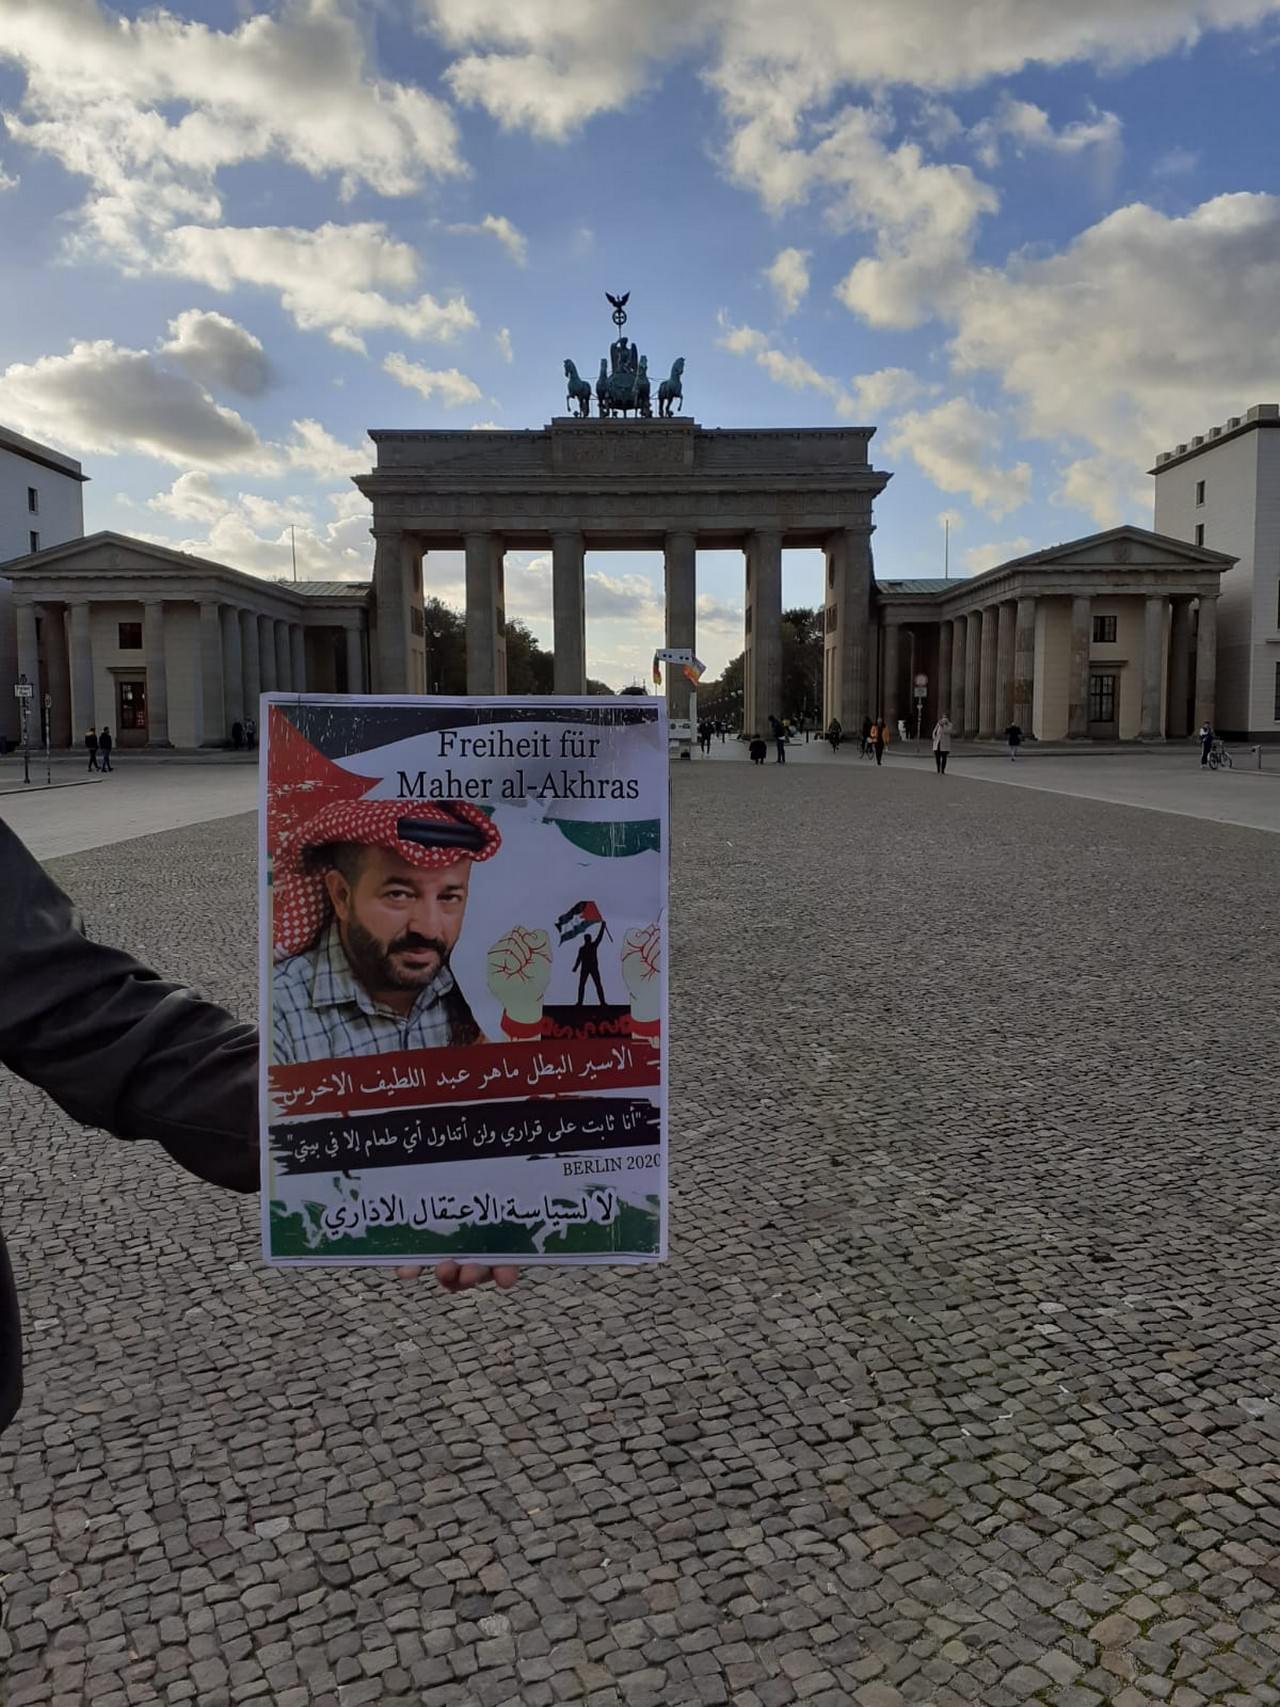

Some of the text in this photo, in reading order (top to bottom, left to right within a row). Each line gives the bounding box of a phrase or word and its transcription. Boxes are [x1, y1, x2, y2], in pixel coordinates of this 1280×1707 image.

[438, 729, 601, 758] Freiheit für
[396, 769, 640, 800] Maher al-Akhras
[283, 1044, 633, 1106] الاسير البطل ماهر عبد اللطيف الاخرس
[427, 1116, 468, 1147] أتناول
[472, 1123, 496, 1147] ولن
[501, 1119, 543, 1147] قراري
[547, 1117, 577, 1142] على
[582, 1112, 615, 1141] ثابت
[324, 1131, 340, 1158] في
[364, 1128, 398, 1157] طعام
[562, 1153, 661, 1177] BERLIN 2020
[413, 1192, 499, 1226] الاعتقال
[506, 1194, 589, 1227] لسياسة
[596, 1190, 614, 1222] لا
